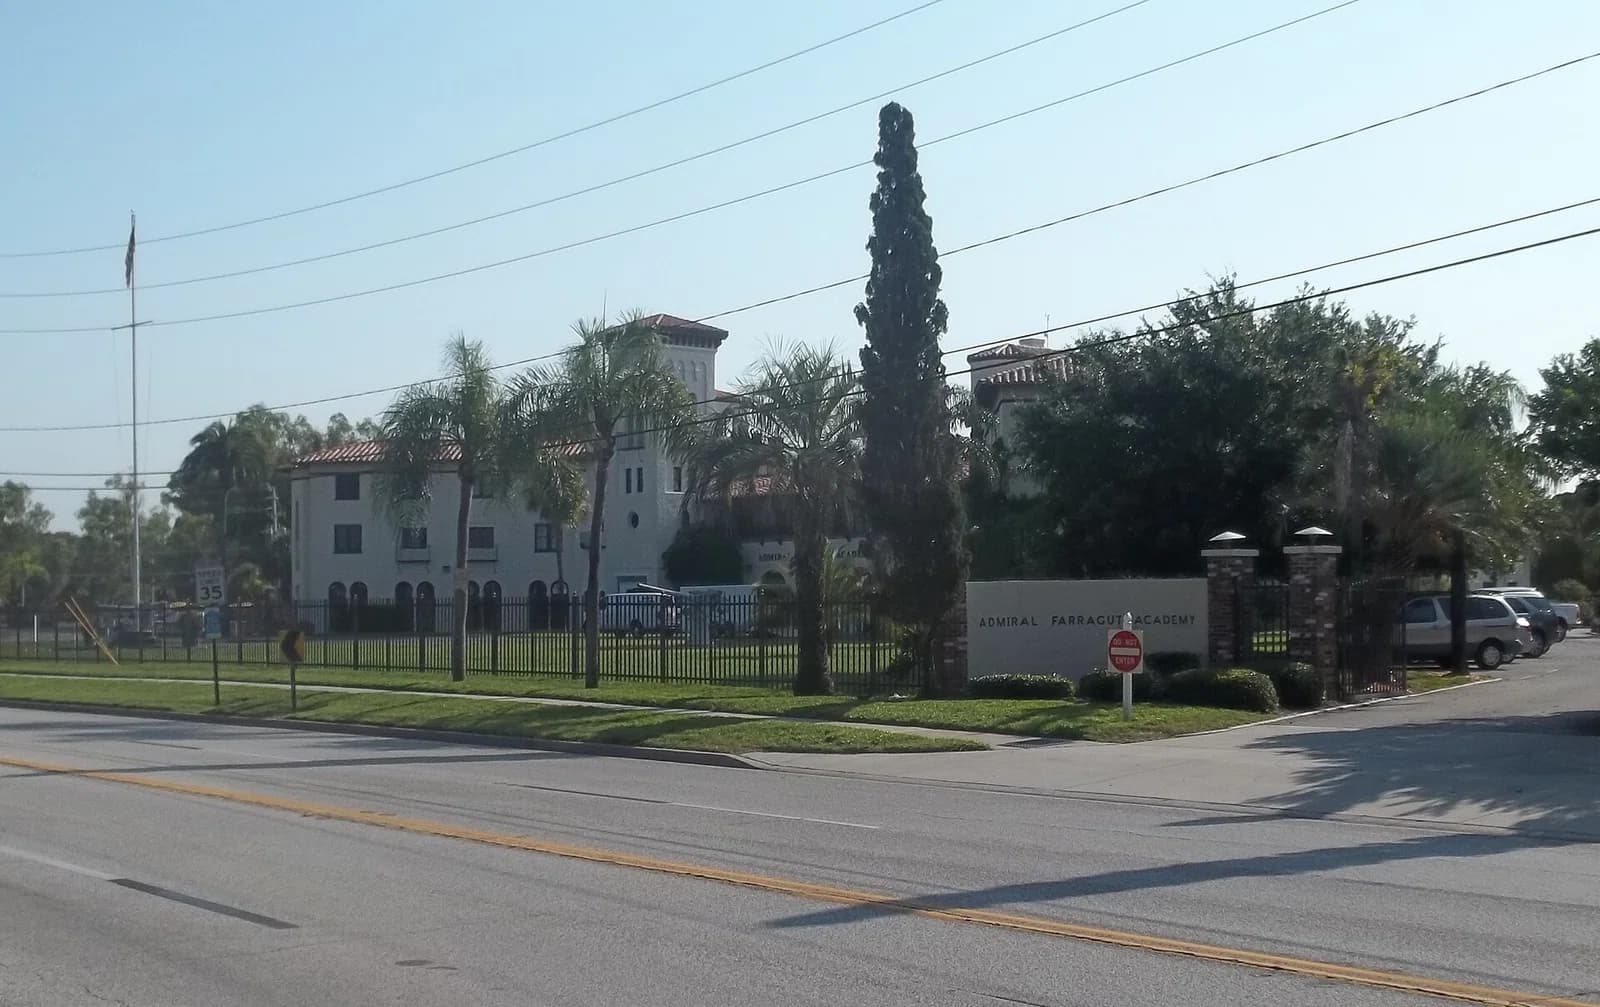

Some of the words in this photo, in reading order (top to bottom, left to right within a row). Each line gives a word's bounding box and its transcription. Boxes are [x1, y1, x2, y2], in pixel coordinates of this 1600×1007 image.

[200, 585, 222, 600] 35
[979, 616, 1039, 628] ADMIRAL
[1051, 615, 1122, 625] FARRAGUT
[1134, 615, 1195, 625] ACADEMY
